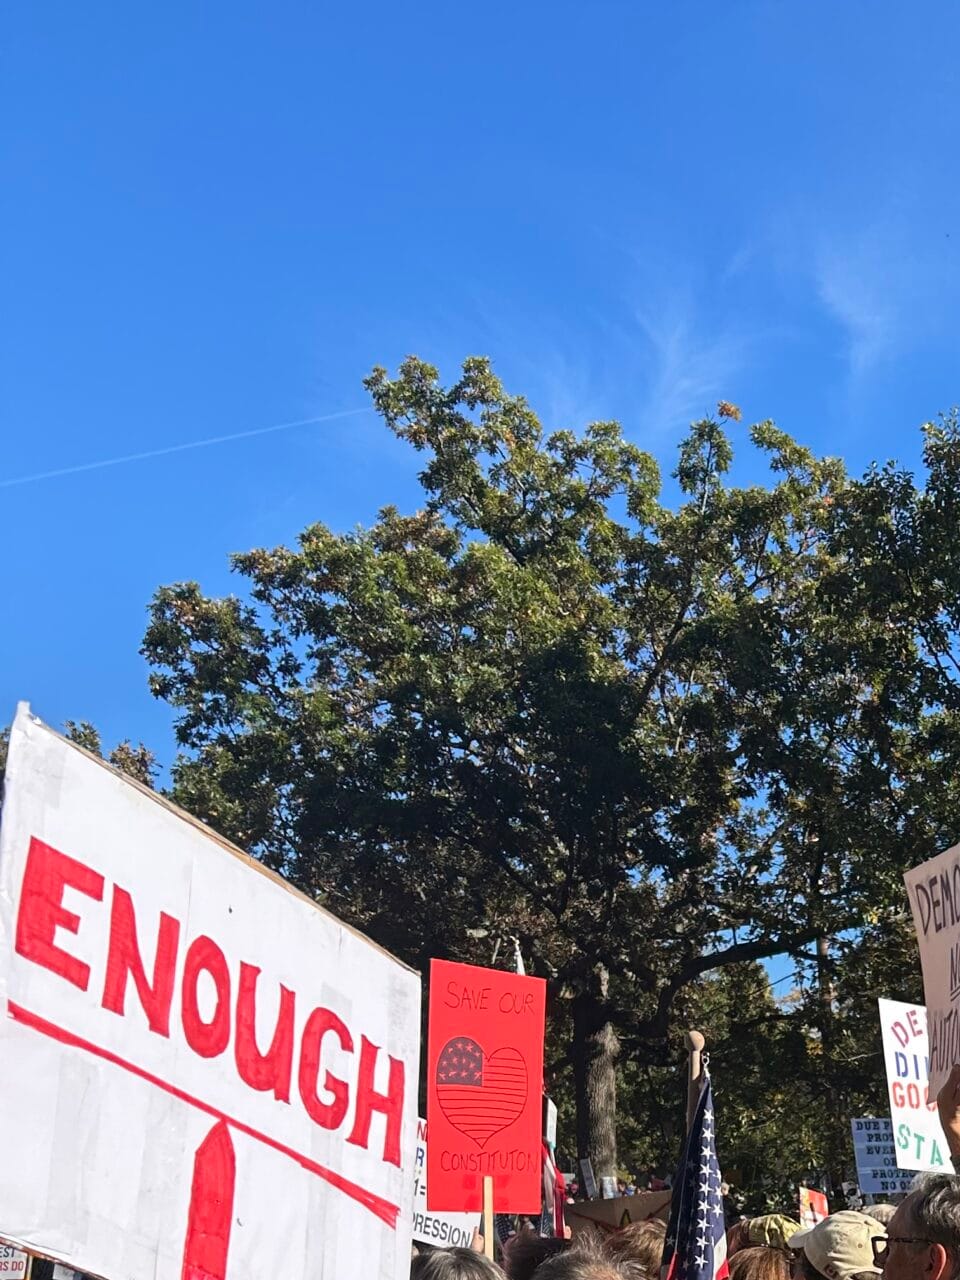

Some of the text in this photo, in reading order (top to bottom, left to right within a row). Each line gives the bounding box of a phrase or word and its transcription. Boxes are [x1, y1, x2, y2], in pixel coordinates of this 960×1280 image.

[15, 835, 404, 1168] ENOUGH
[445, 981, 536, 1015] SAVE OUR
[856, 1121, 880, 1131] DUE
[896, 1123, 945, 1167] STA
[413, 1212, 471, 1248] RESSION
[11, 1260, 25, 1272] DO
